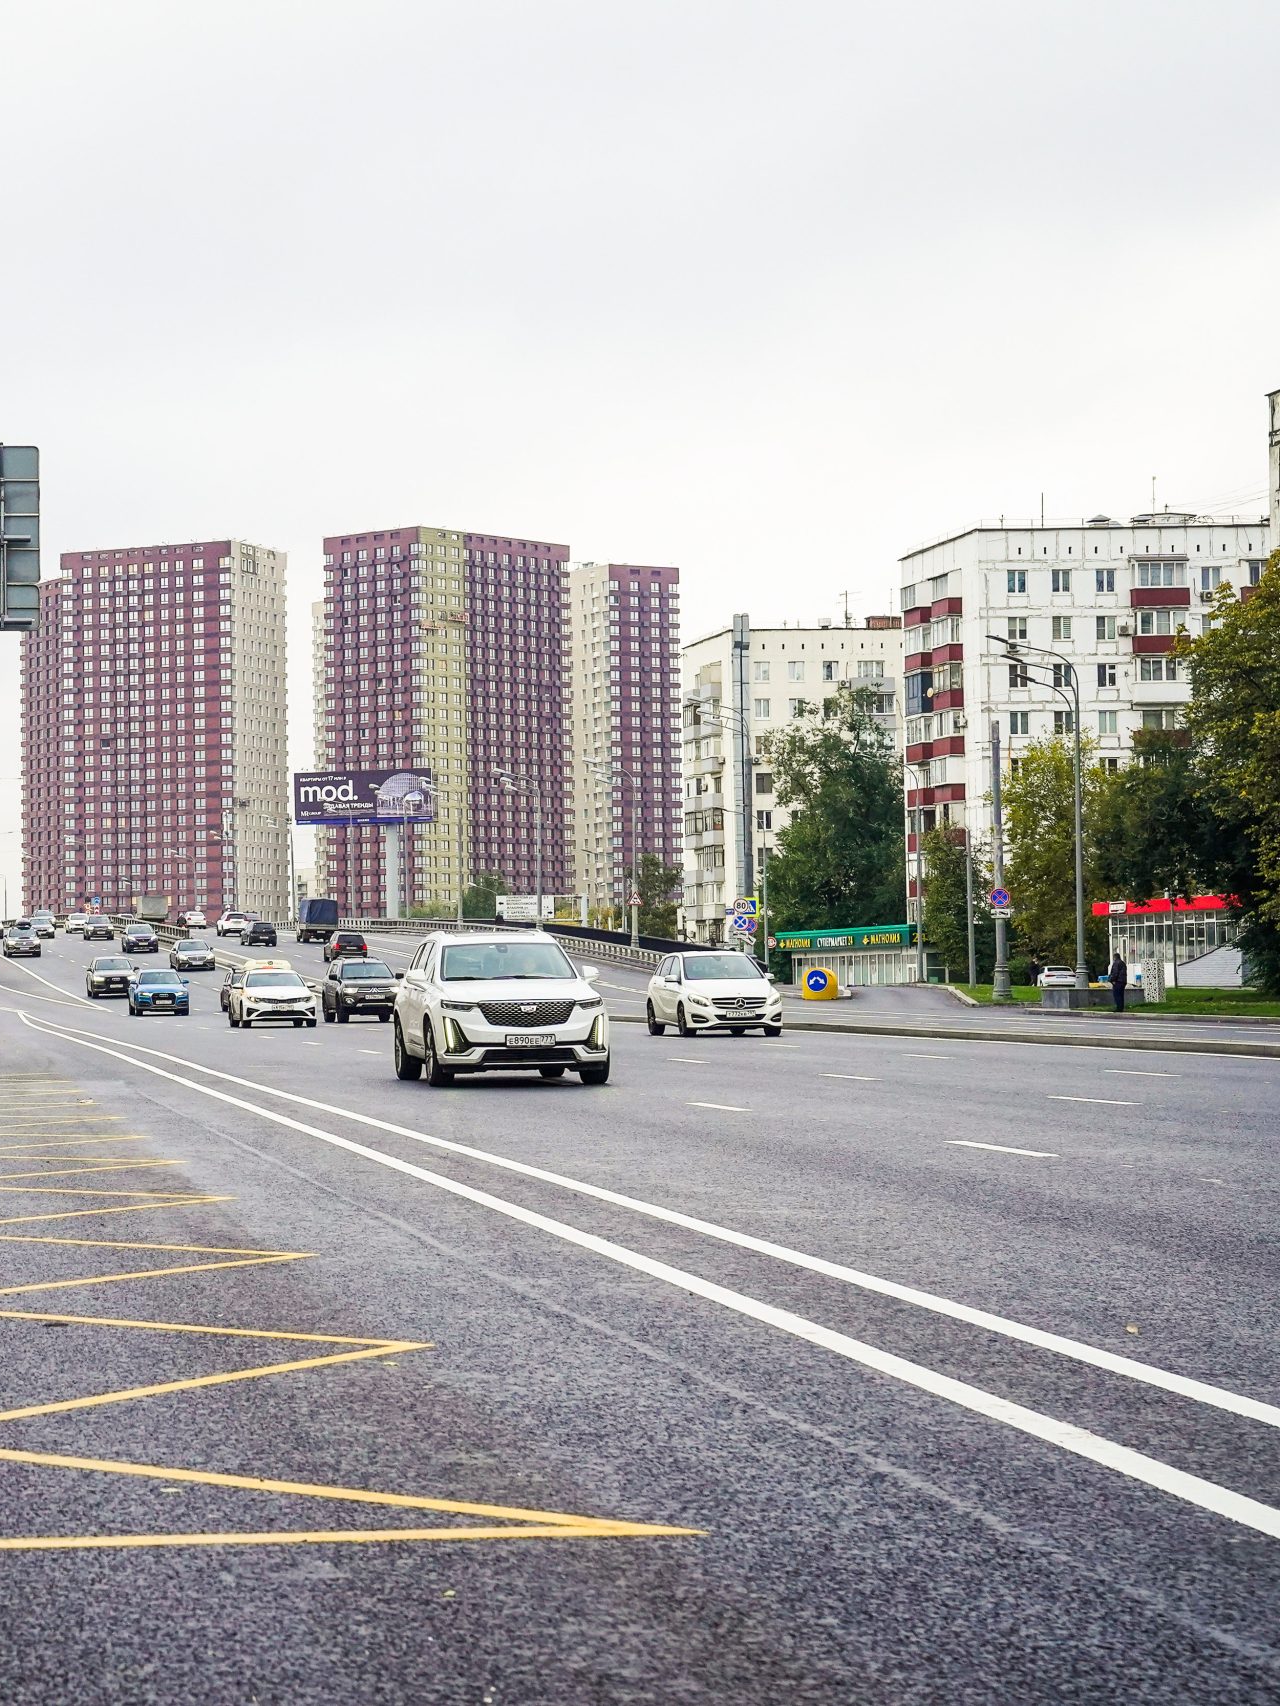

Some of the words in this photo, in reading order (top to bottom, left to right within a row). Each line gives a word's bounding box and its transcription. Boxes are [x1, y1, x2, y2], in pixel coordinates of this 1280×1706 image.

[786, 938, 810, 948] МАГНОЛИЯ
[817, 936, 847, 947] СУПЕРМАРКЕТ
[870, 933, 900, 944] МАГНОЛИЯ
